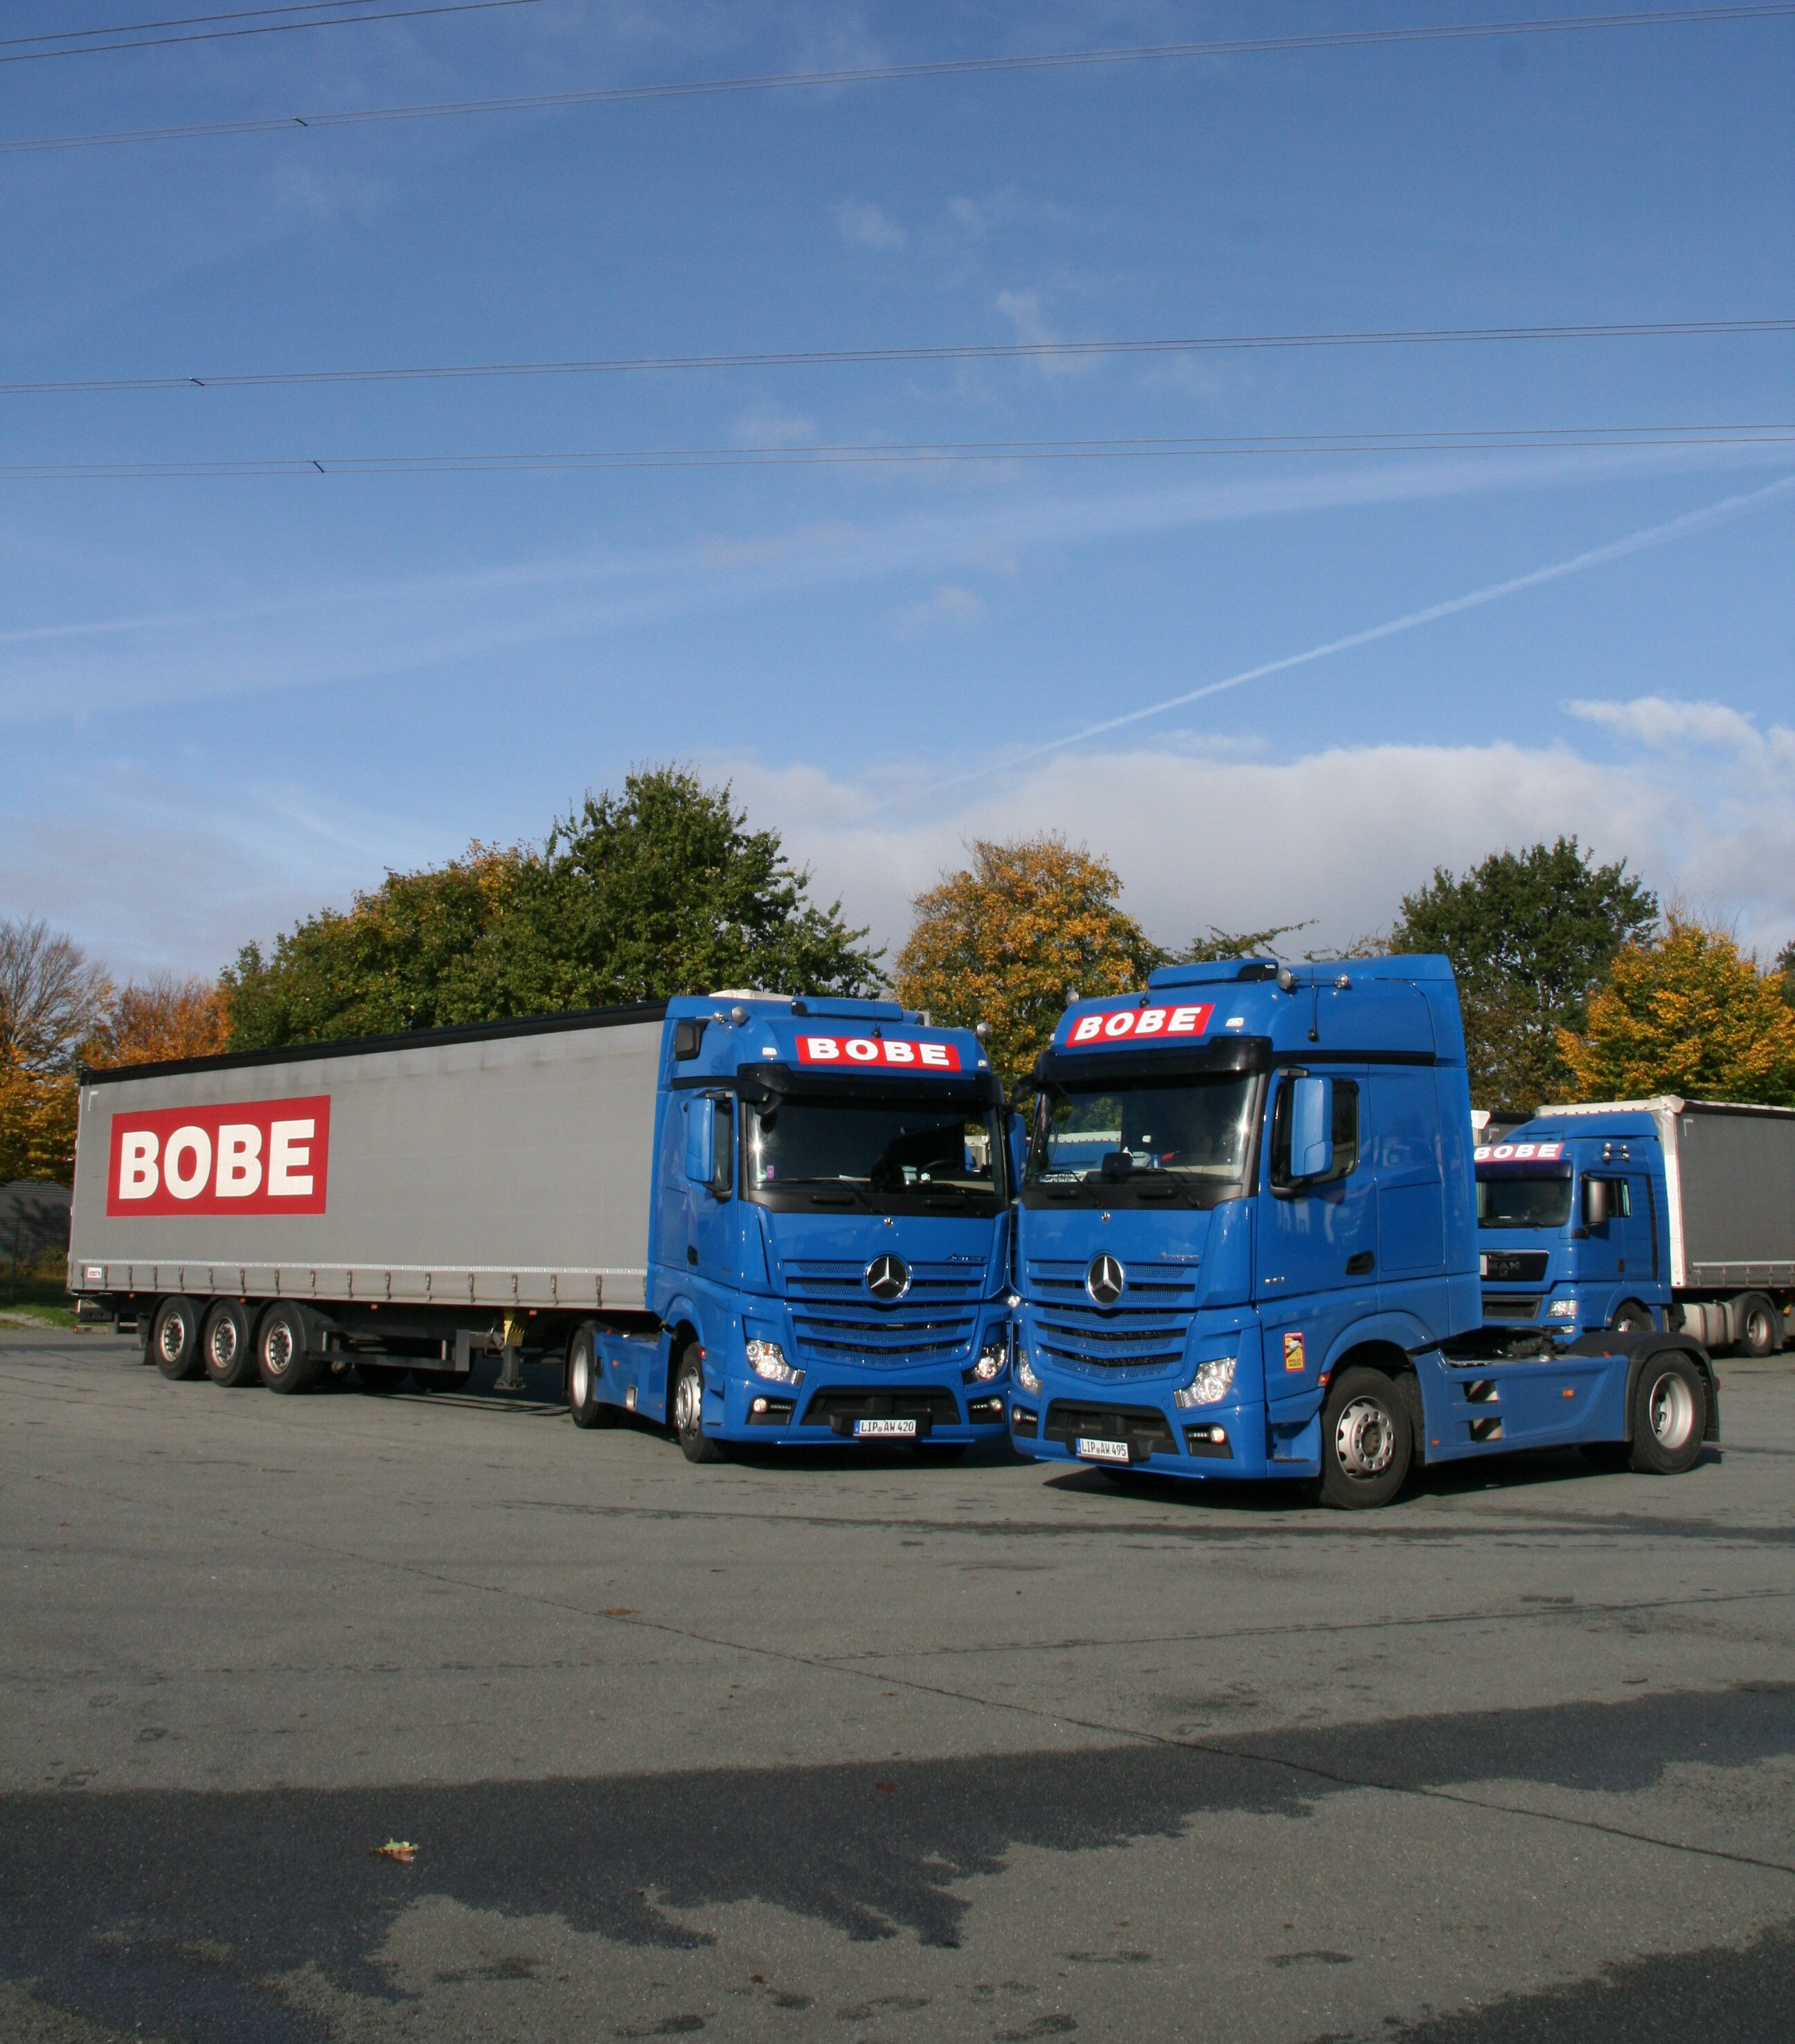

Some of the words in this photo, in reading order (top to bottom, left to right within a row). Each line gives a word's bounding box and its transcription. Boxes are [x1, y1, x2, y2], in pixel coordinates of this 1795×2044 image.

[1074, 1007, 1202, 1041] BOBE
[807, 1037, 950, 1066] BOBE
[118, 1118, 315, 1200] BOBE
[1474, 1144, 1560, 1160] BOBE
[861, 1422, 878, 1432] LIP
[898, 1421, 914, 1432] 420
[1082, 1440, 1096, 1453] LIP
[1111, 1444, 1126, 1456] 495
